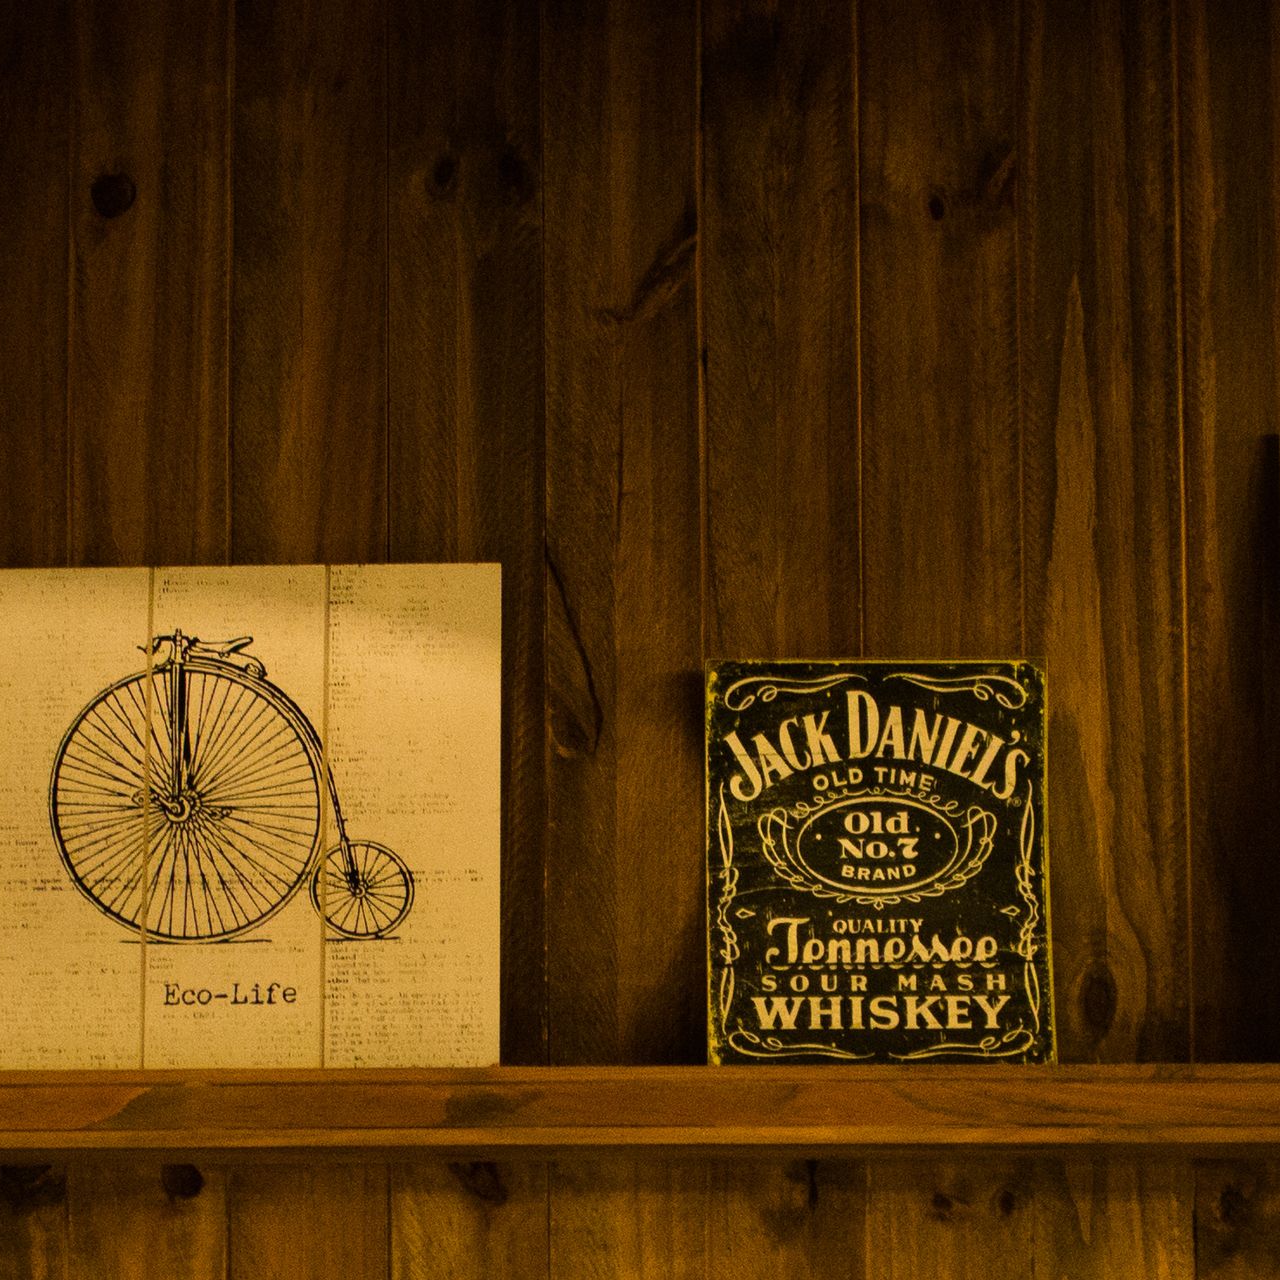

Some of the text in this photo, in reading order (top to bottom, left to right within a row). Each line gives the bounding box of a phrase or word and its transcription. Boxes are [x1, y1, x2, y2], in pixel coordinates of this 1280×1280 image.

[723, 690, 1032, 802] JACK DANIEL'S
[812, 766, 936, 791] OLD TIME
[844, 811, 910, 834] Old
[841, 864, 917, 881] BRAND
[832, 918, 924, 934] QUALITY
[766, 917, 998, 967] Tennessee
[163, 982, 298, 1007] Eco-Life
[761, 973, 1006, 992] SOUR MASH
[752, 996, 1012, 1031] WHISKEY
